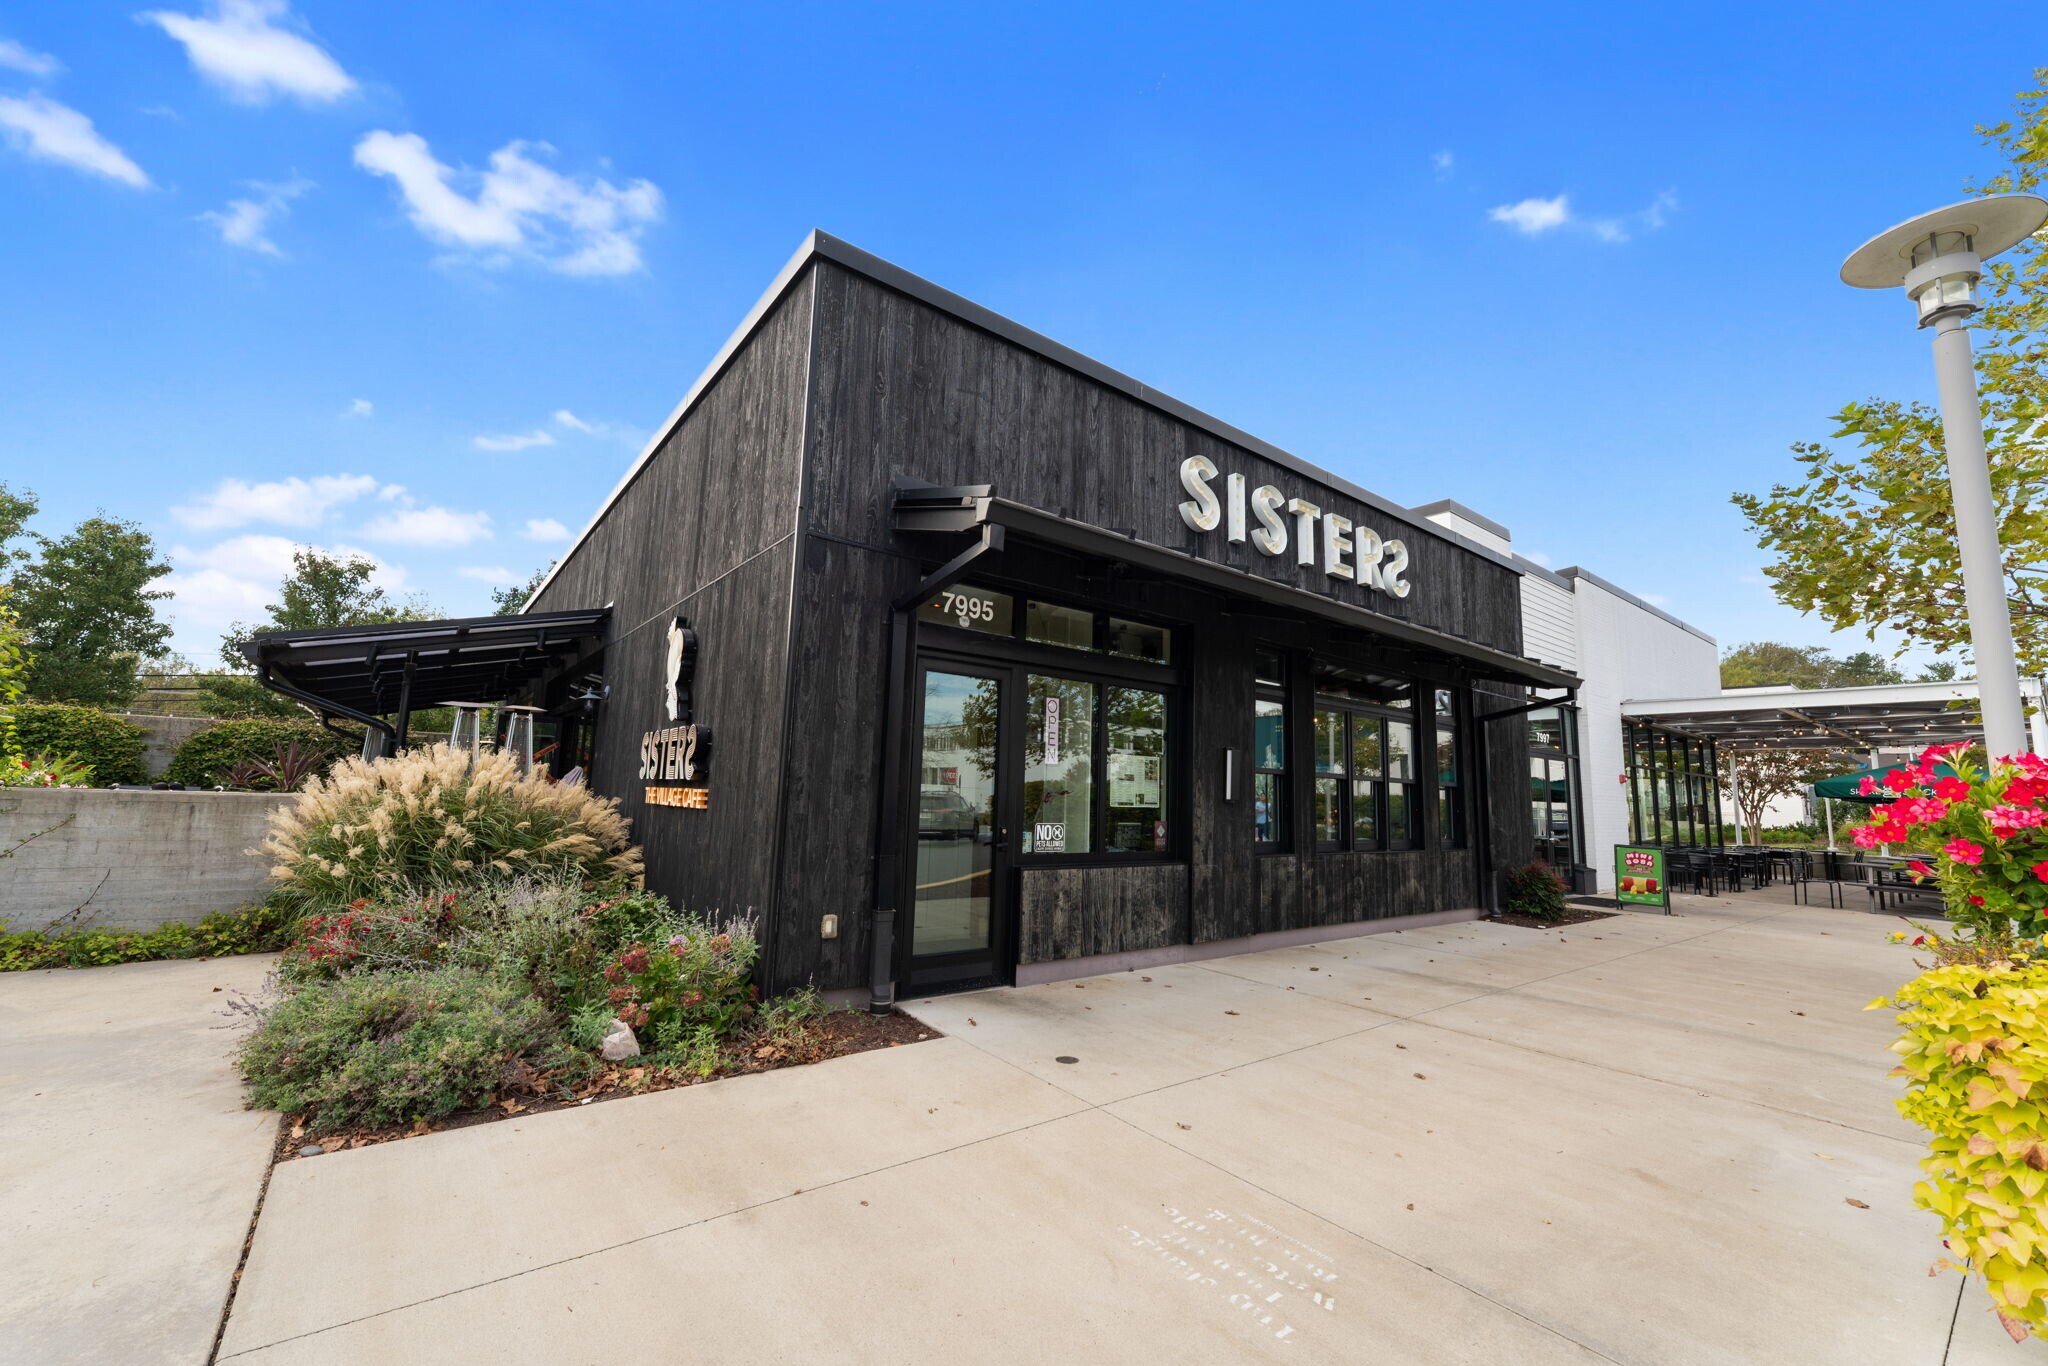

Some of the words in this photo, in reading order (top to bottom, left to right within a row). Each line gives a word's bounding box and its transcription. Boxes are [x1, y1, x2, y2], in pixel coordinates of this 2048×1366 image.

[1179, 455, 1410, 598] SISTERS
[942, 592, 994, 621] 7995
[1048, 700, 1058, 762] OPEN
[1536, 732, 1550, 743] 7997
[639, 724, 698, 780] SISTERS
[645, 787, 657, 803] THE
[1036, 825, 1051, 840] NO
